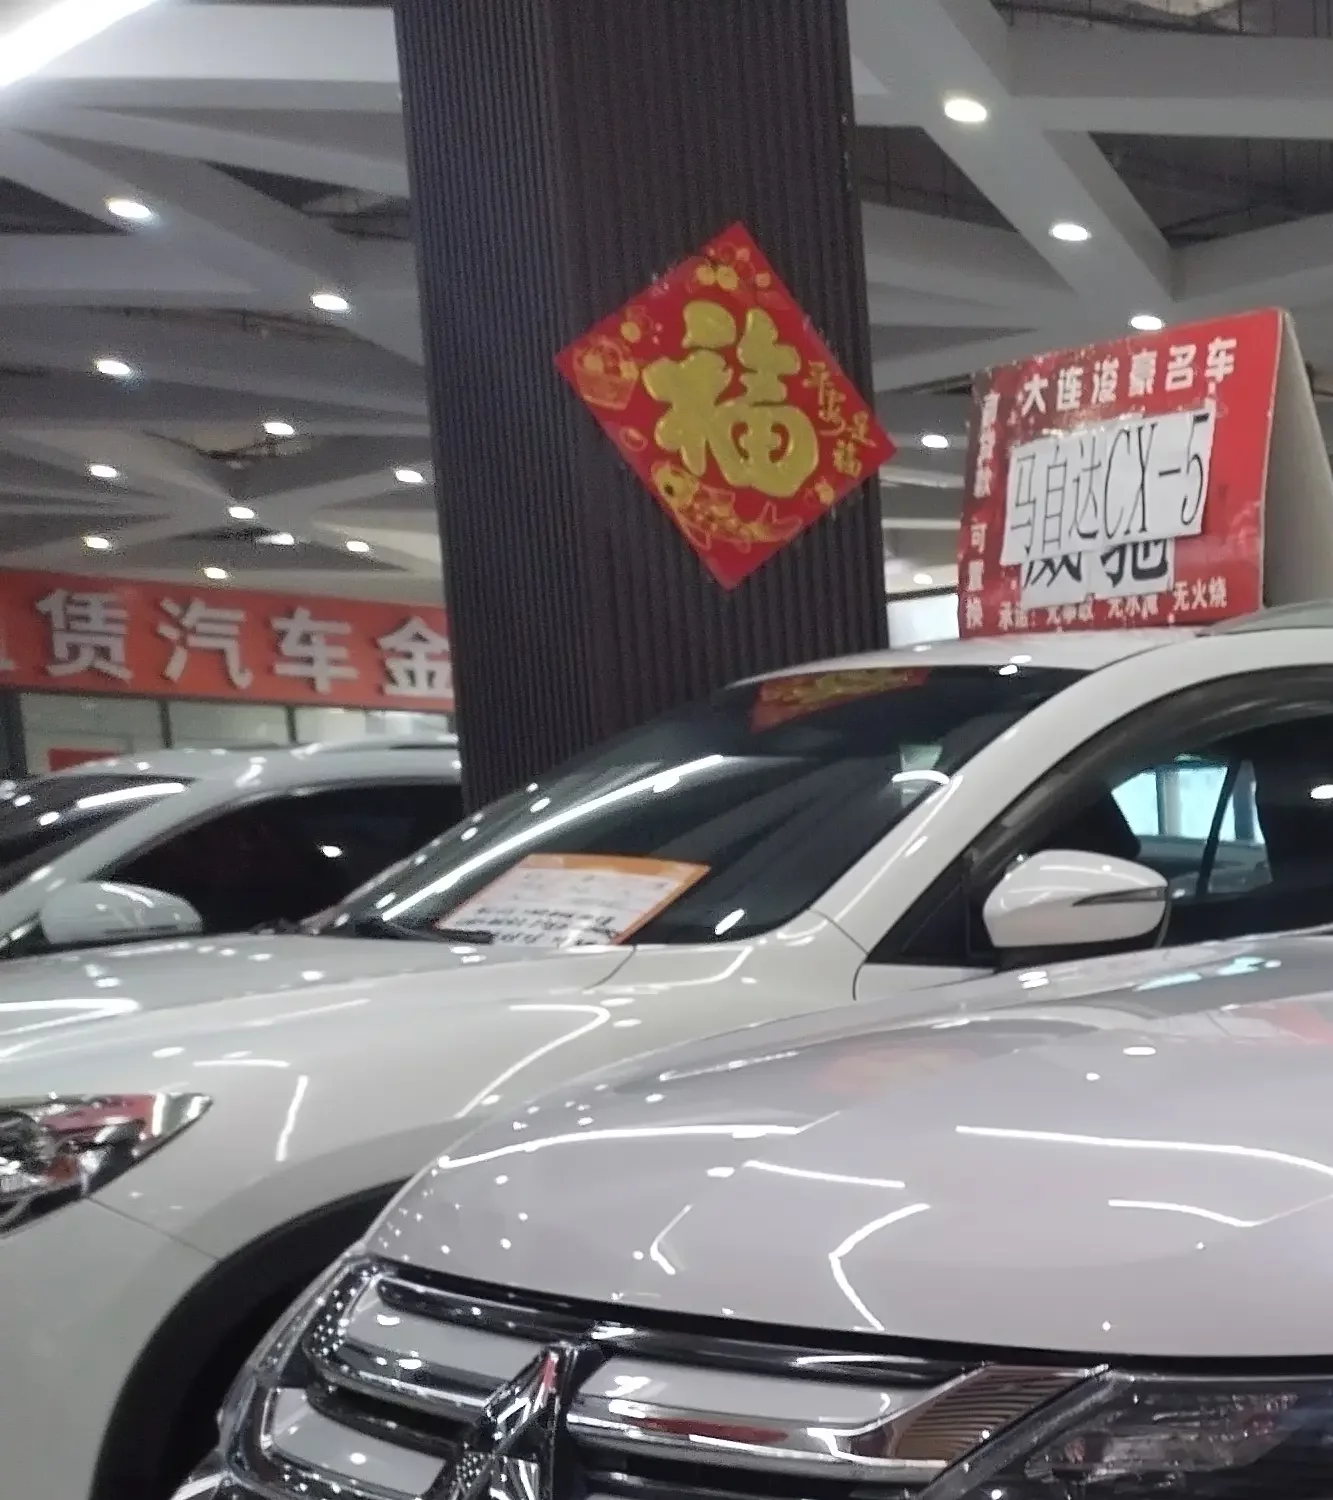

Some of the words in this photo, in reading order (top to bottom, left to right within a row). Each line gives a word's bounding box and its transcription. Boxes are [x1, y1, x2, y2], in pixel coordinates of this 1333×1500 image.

[642, 300, 820, 498] 福
[1010, 411, 1212, 556] 马自达CX-5
[1172, 576, 1229, 612] 无火烧
